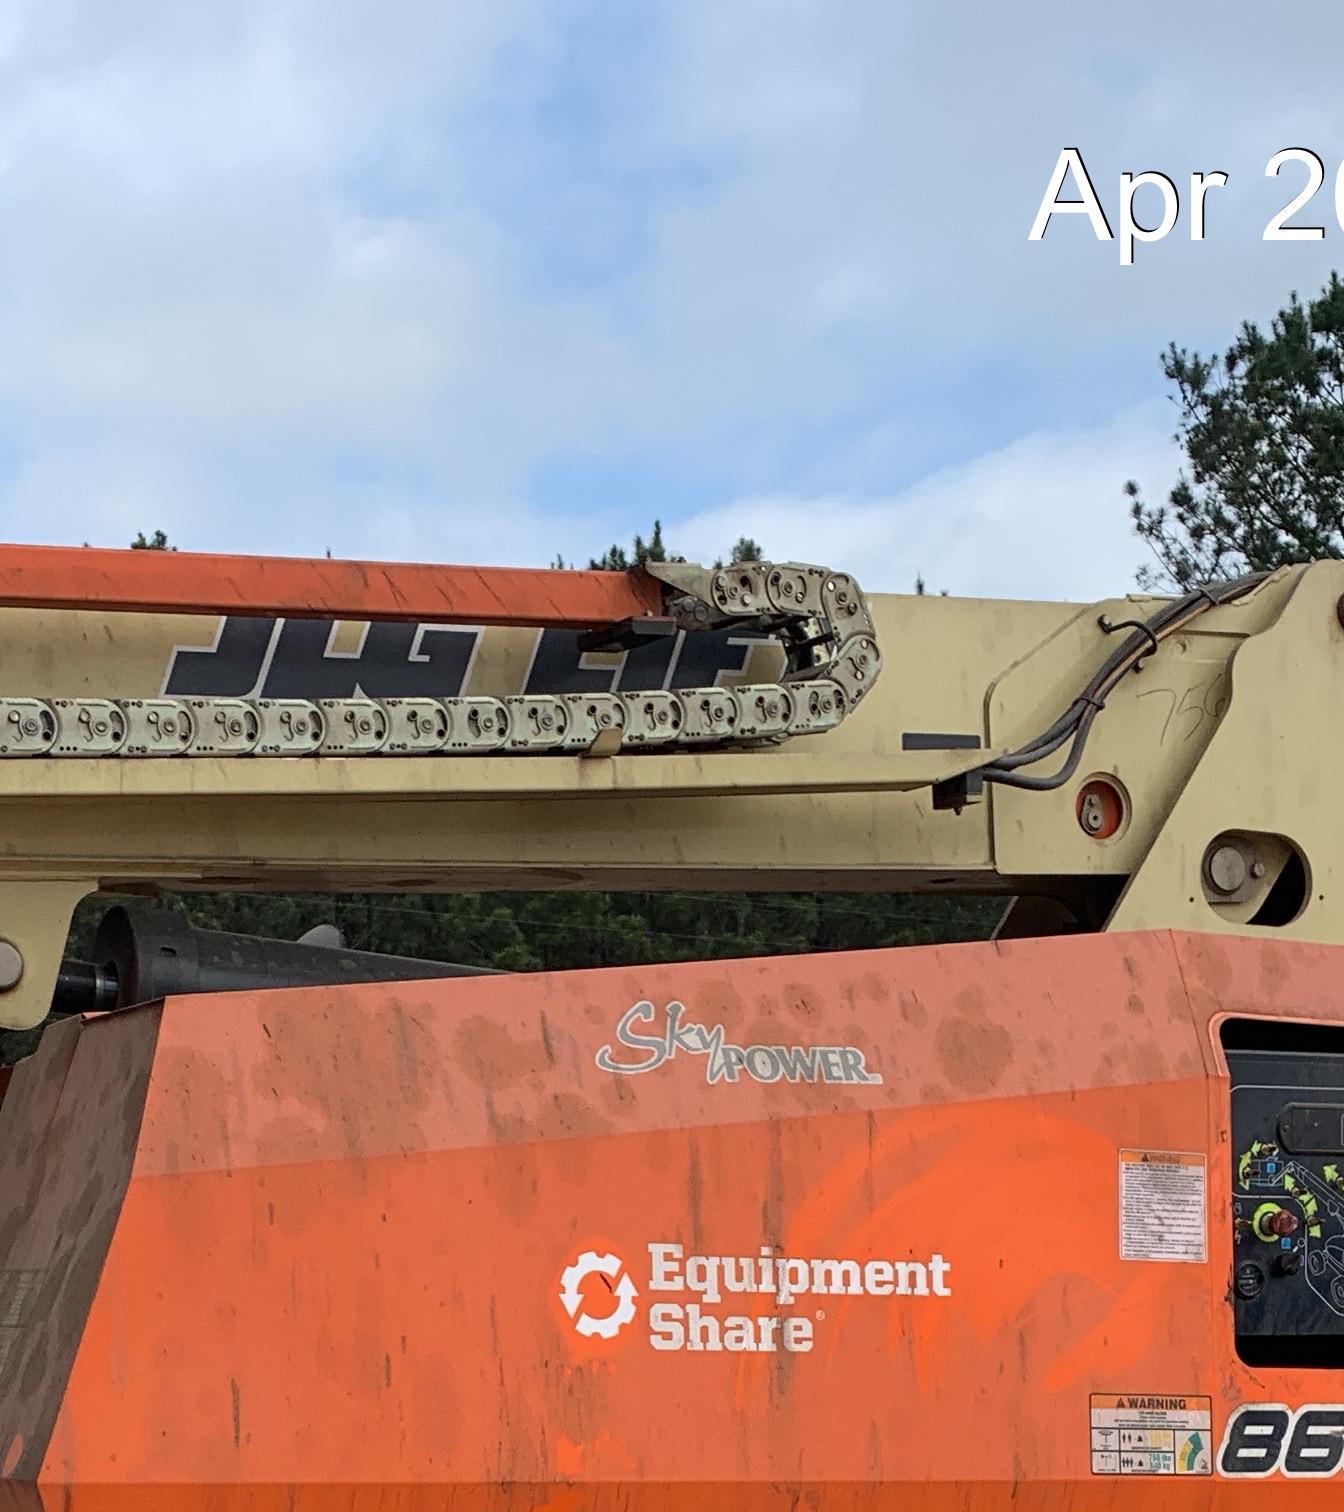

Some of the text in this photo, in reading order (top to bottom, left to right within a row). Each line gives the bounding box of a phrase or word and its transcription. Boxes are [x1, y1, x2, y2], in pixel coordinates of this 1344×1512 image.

[648, 1242, 951, 1305] Equipment
[649, 1303, 815, 1352] Share
[1128, 1397, 1187, 1410] WARNING
